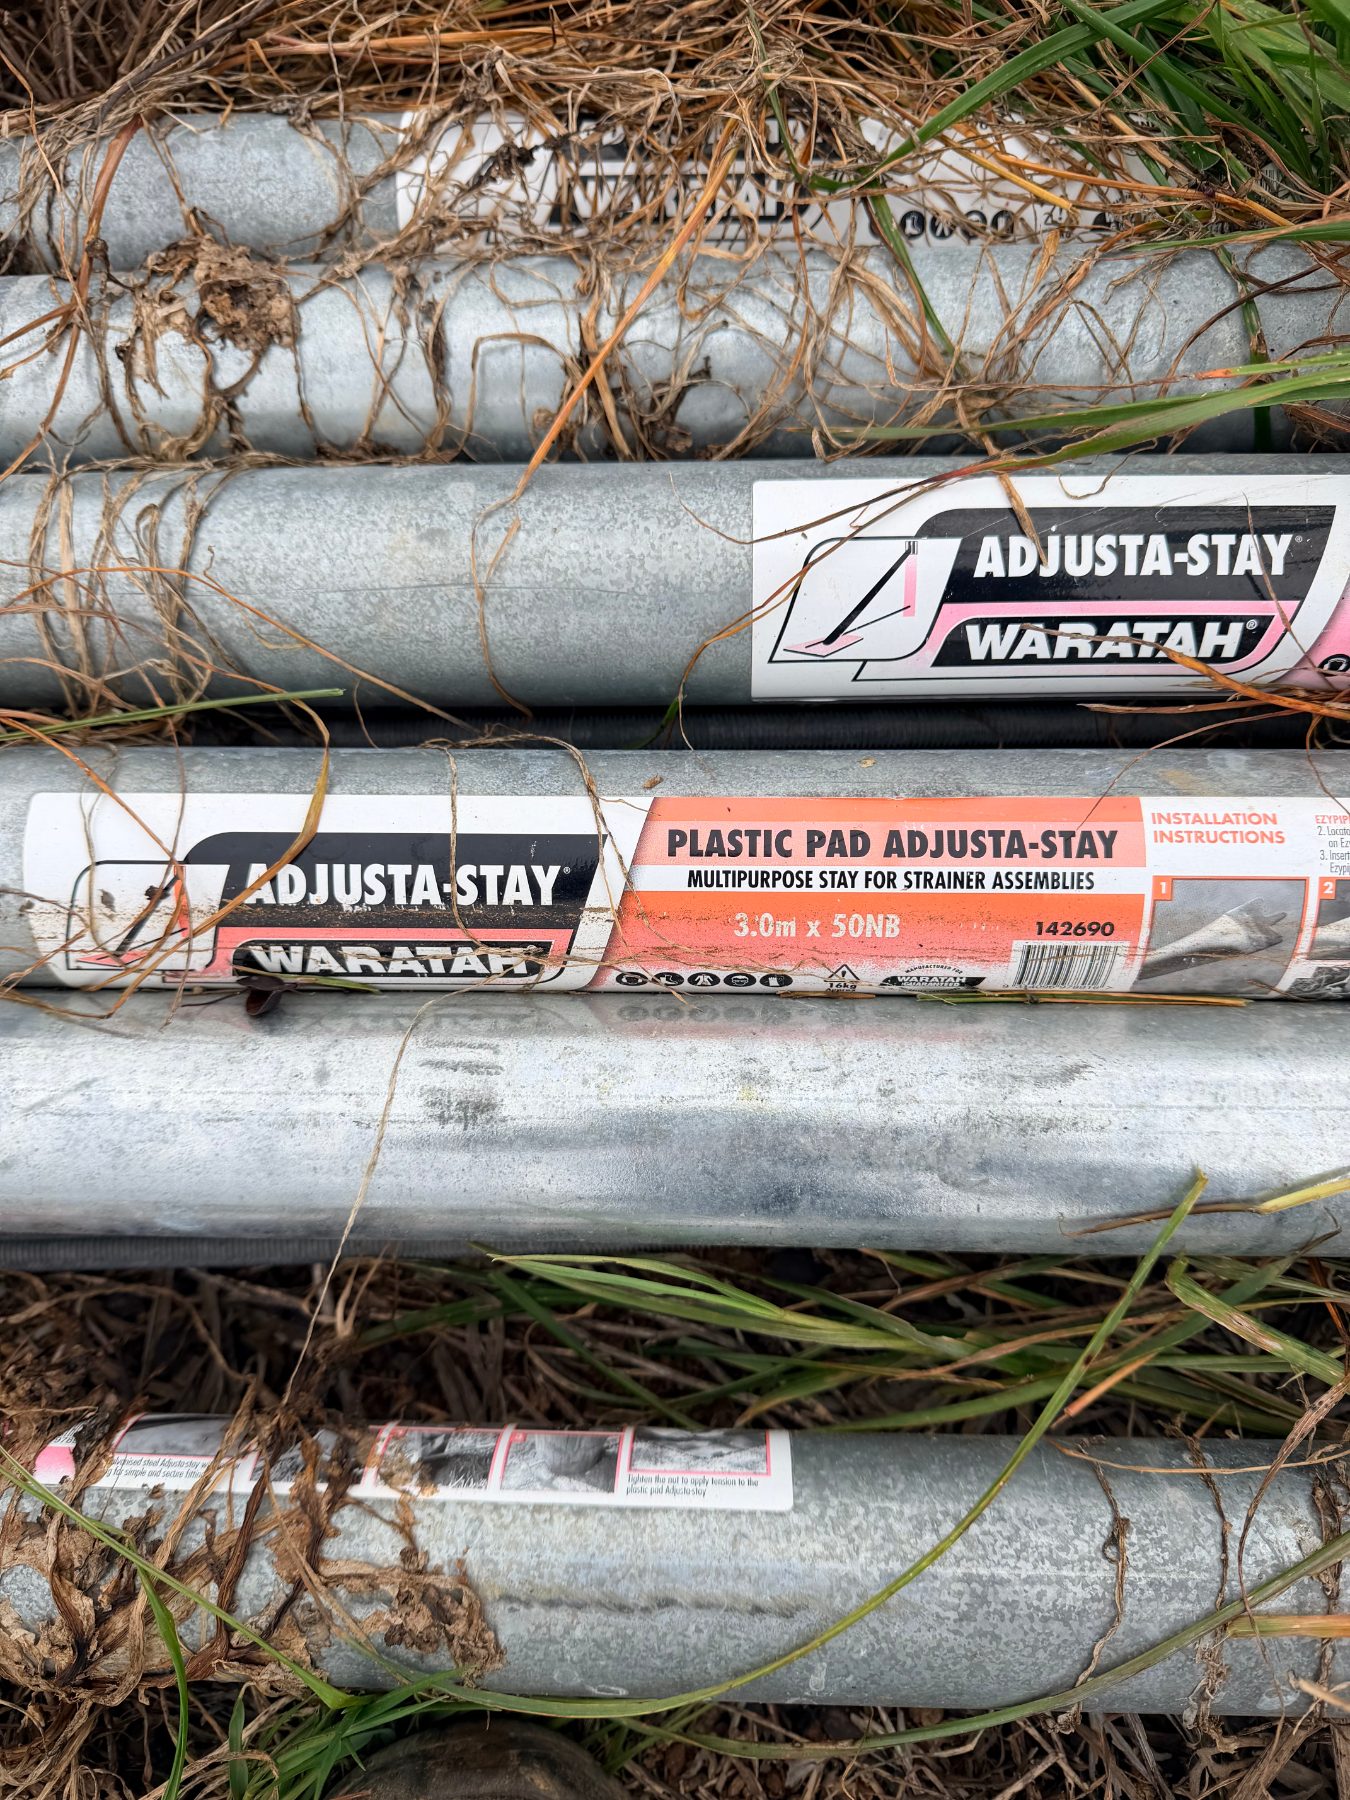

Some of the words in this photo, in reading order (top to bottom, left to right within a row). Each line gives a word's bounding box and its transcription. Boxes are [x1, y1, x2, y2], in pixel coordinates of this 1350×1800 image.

[1151, 813, 1278, 825] INSTALLATION
[667, 829, 792, 857] PLASTIC
[806, 830, 871, 858] PAD
[883, 829, 1118, 859] ADJUSTA-STAY
[1153, 830, 1285, 844] INSTRUCTIONS
[687, 870, 813, 889] MULTIPURPOSE
[819, 870, 859, 889] STAY
[864, 870, 897, 889] FOR
[903, 870, 986, 890] STRAINER
[992, 871, 1095, 890] ASSEMBLIES
[1160, 882, 1166, 894] 1
[1323, 882, 1334, 894] 2
[734, 912, 796, 937] 3.0m
[806, 919, 822, 937] x
[831, 913, 900, 938] 50NB
[1035, 921, 1115, 937] 142690
[829, 982, 857, 990] 16kg
